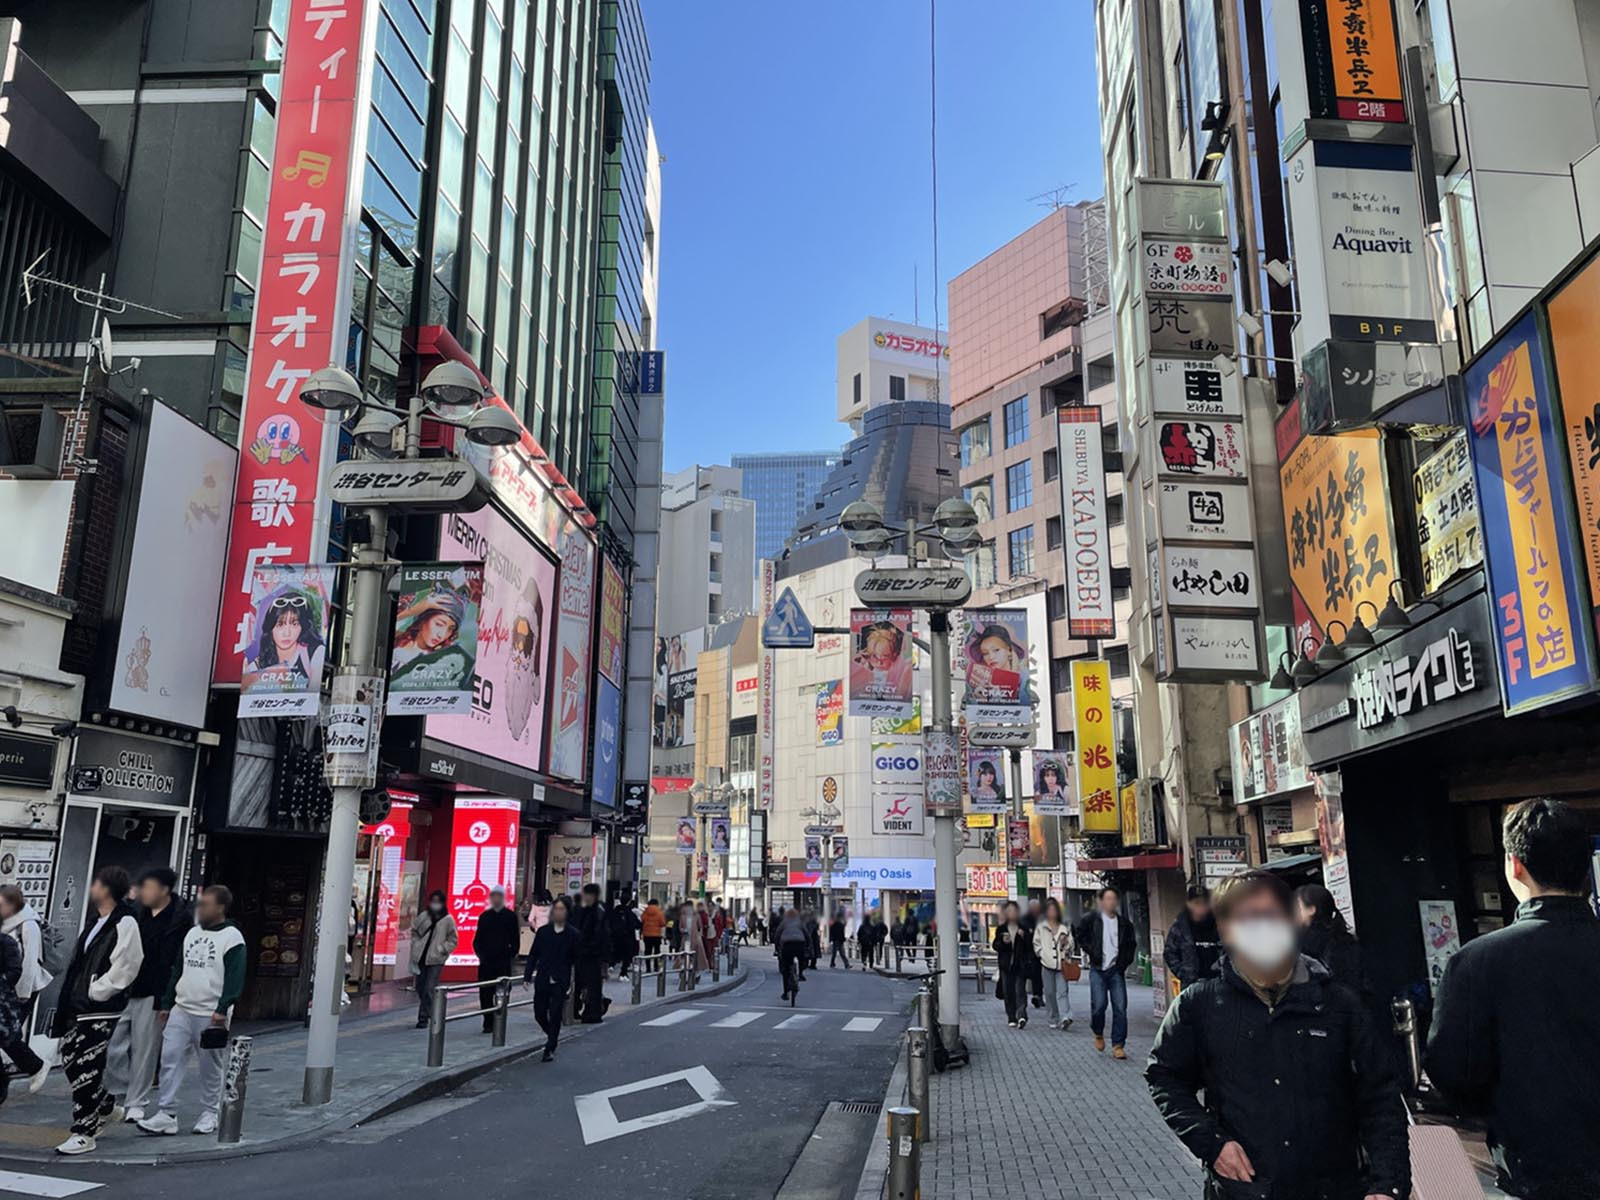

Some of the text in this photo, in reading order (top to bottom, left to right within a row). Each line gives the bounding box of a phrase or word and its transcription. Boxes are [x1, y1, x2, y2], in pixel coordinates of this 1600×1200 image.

[1357, 101, 1386, 118] 2階
[1344, 225, 1396, 237] Dining Bar
[1146, 244, 1170, 258] 6F
[1332, 232, 1413, 256] Aquavit
[264, 202, 327, 404] カラオケ
[886, 333, 943, 357] カラオケ
[333, 469, 468, 490] 渋谷センター街
[1071, 428, 1102, 612] SHIBUYA KADOEBI
[861, 576, 964, 592] 渋谷センター街
[1499, 591, 1524, 686] 3F
[261, 672, 301, 682] CRAZY
[410, 670, 452, 680] CRAZY
[1352, 636, 1456, 730] 焼肉ライク
[864, 684, 897, 693] CRAZY
[981, 688, 1015, 698] CRAZY
[119, 750, 154, 773] CHILL
[875, 756, 919, 771] GiGO
[763, 756, 772, 806] カラオケ
[473, 826, 488, 838] 2F
[883, 820, 912, 831] VIDENT
[879, 867, 913, 879] Oasis
[972, 871, 986, 890] 50
